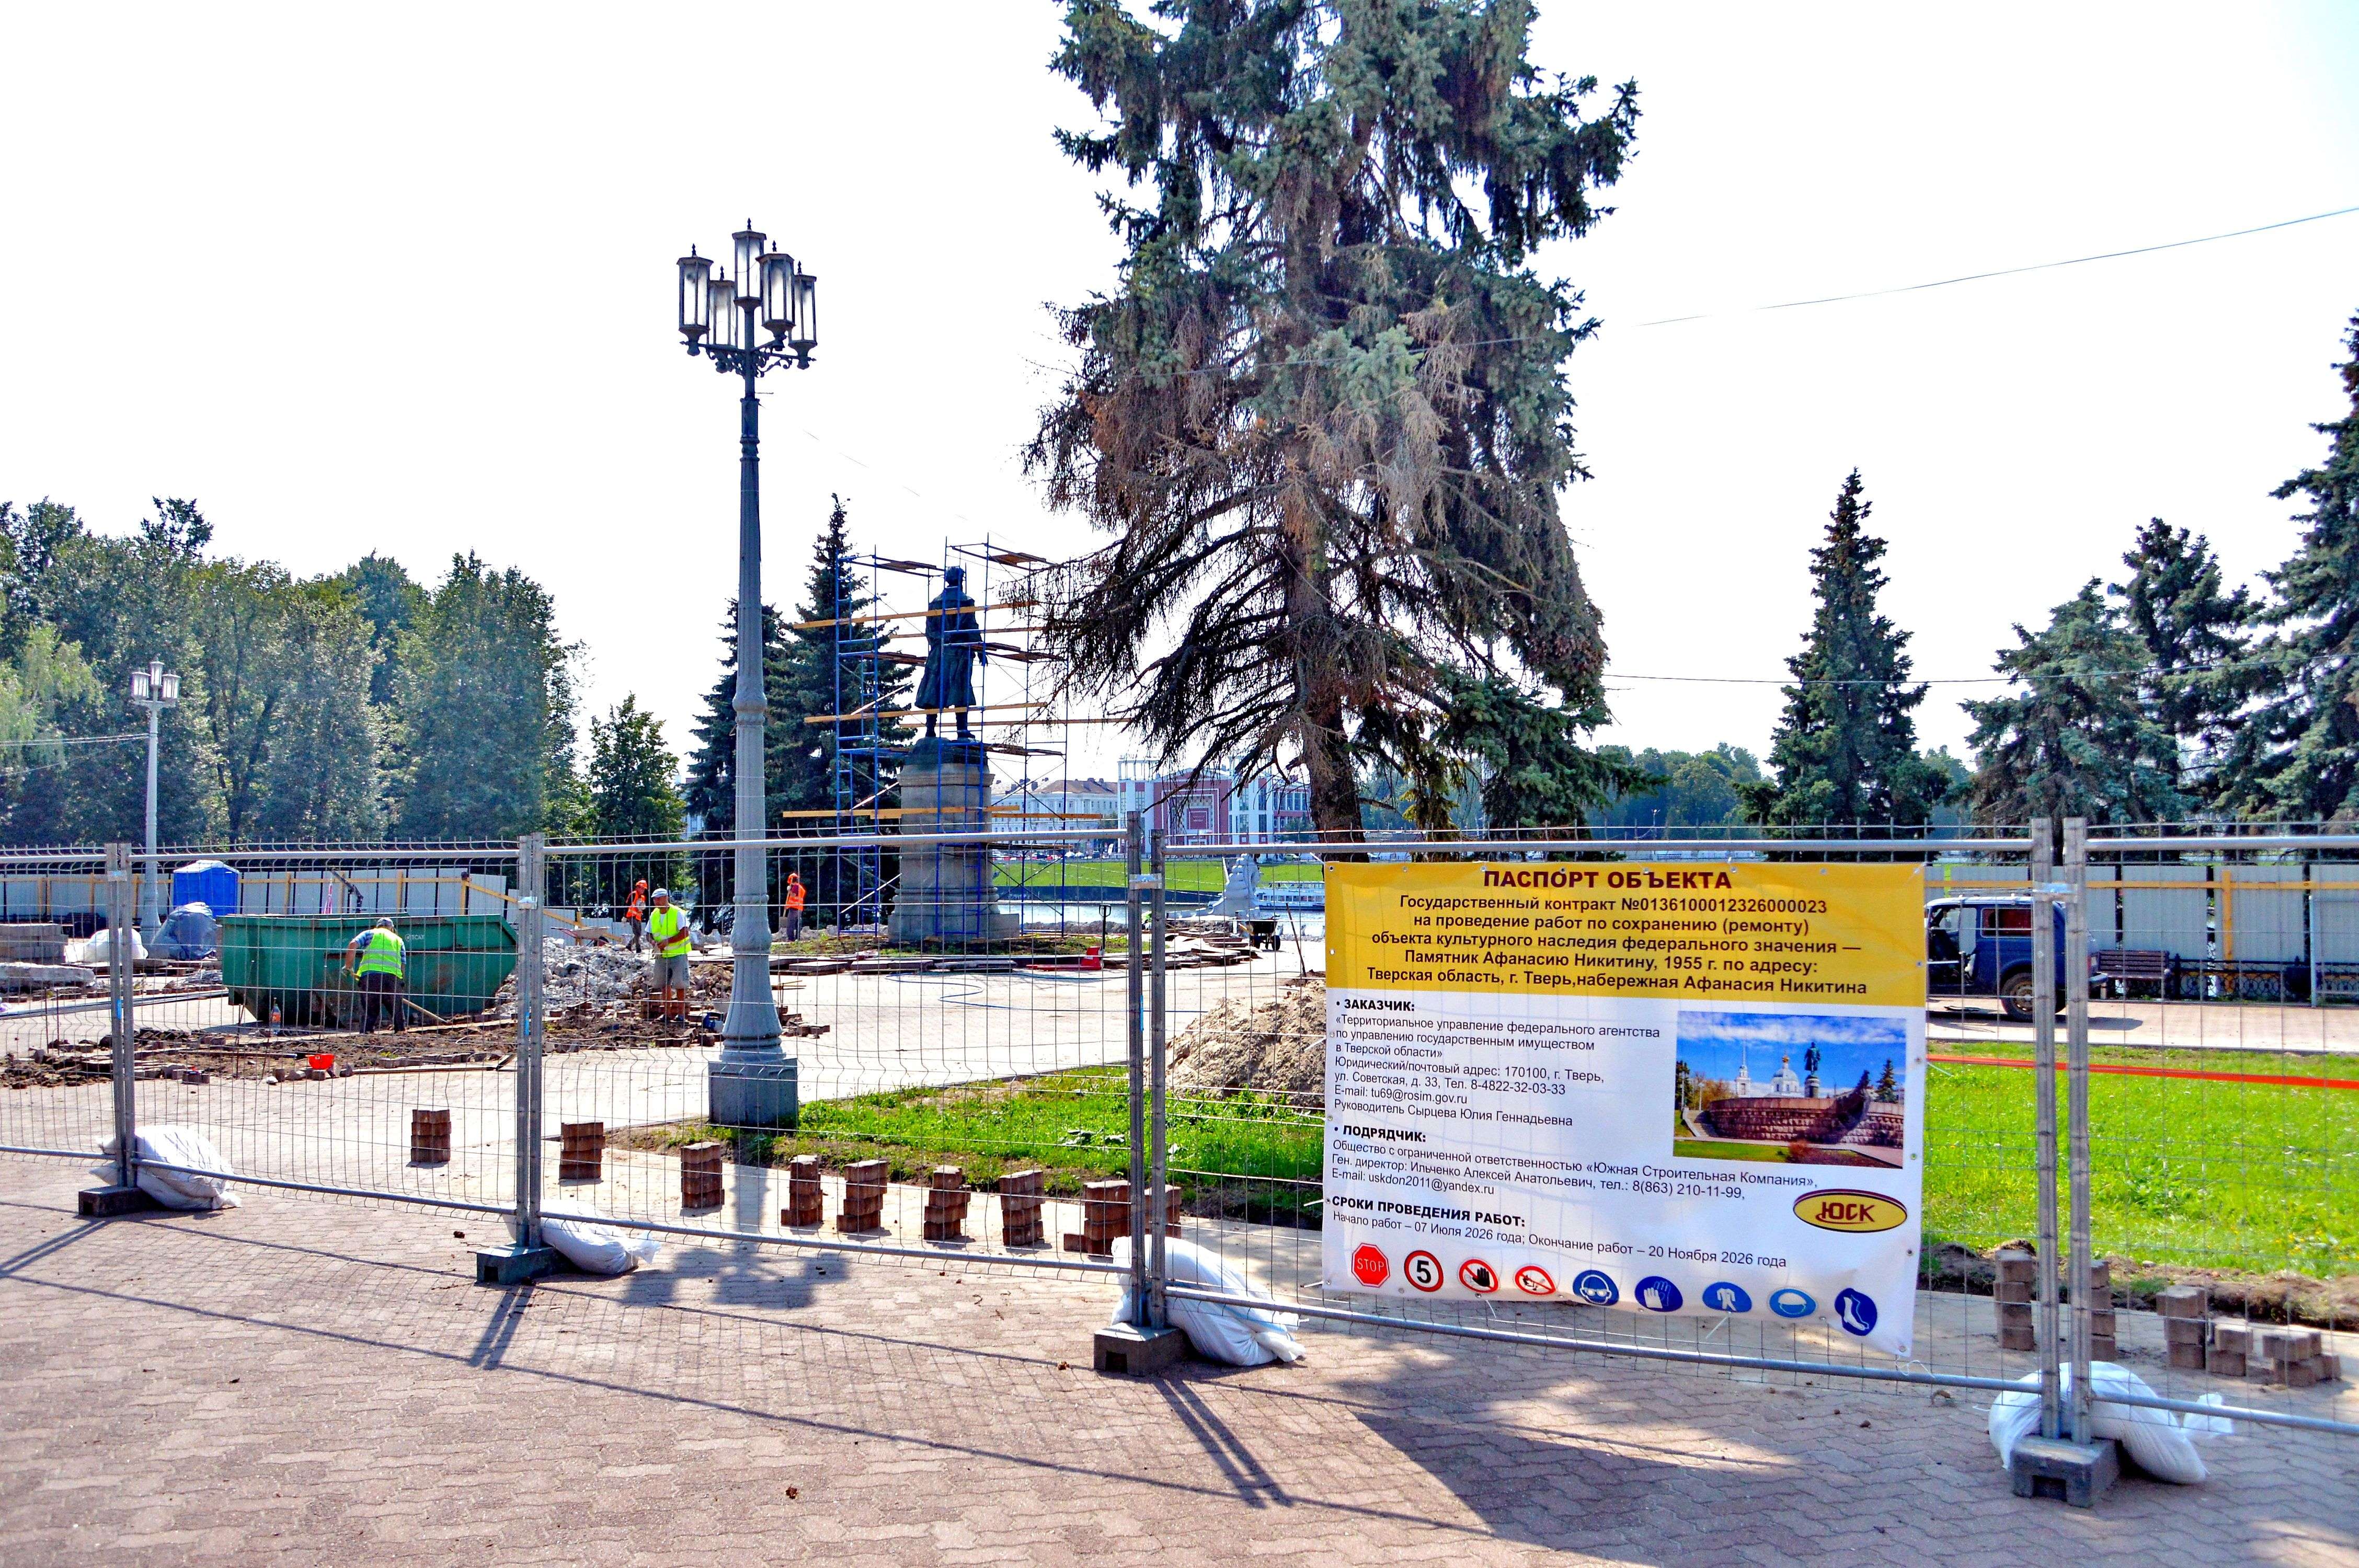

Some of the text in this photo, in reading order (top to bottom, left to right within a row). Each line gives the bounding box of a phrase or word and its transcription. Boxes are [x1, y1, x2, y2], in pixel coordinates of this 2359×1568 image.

[1484, 871, 1732, 889] ПАСПОРТ ОБЪЕКТА
[1400, 895, 1827, 913] Государственный контракт №0136100012326000023
[1414, 916, 1809, 936] на проведение работ по сохранению (ремонту)
[1372, 932, 1432, 944] объекта
[1437, 935, 1533, 948] культурного
[1538, 938, 1617, 949] наследия
[1622, 937, 1748, 952] федерального
[1754, 942, 1836, 953] значения
[1405, 950, 1817, 975] Памятник Афанасию Никитину, 1955 г. по адресу:
[1367, 967, 1866, 994] Тверская область, г. Тверь,набережная Афанасия Никитина
[1344, 999, 1414, 1011] ЗАКАЗЧИК:
[1336, 1014, 1660, 1037] «Территориальное управление федерального агентства
[1344, 1042, 1391, 1055] Тверской
[1394, 1046, 1442, 1058] области»
[1350, 1031, 1413, 1042] управлению
[1417, 1034, 1514, 1046] государственным
[1519, 1039, 1595, 1051] имуществом
[1335, 1056, 1459, 1074] Юридический/почтовый
[1463, 1067, 1501, 1077] адрес:
[1505, 1066, 1550, 1080] 170100,
[1565, 1069, 1604, 1083] Тверь,
[1334, 1071, 1565, 1095] ул. Советская, д. 33, Тел. 8-4822-32-03-33
[1335, 1085, 1467, 1104] E-mail: tu69@rosim.gov.ru
[1335, 1099, 1573, 1126] Руководитель Сырцева Юлия Геннадьевна
[1343, 1125, 1426, 1142] ПОДРЯДЧИК:
[1333, 1139, 1385, 1154] Общество
[1398, 1148, 1471, 1162] ограниченной
[1475, 1155, 1582, 1171] ответственностью
[1587, 1162, 1638, 1175] «Южная
[1642, 1166, 1735, 1182] Строительная
[1740, 1172, 1817, 1187] Компания»,
[1332, 1154, 1745, 1200] Ген. директор: Ильченко Алексей Анатольевич, тел.: 8(863) 210-11-99,
[1333, 1168, 1494, 1194] E-mail: uskdon2011@yandex.ru
[1332, 1196, 1525, 1227] СРОКИ ПРОВЕДЕНИЯ РАБОТ:
[1822, 1202, 1875, 1223] ЮСК
[1333, 1211, 1368, 1226] Начало
[1372, 1217, 1402, 1229] работ
[1415, 1221, 1427, 1232] 07
[1432, 1224, 1461, 1237] Июля
[1465, 1227, 1493, 1240] 2026
[1497, 1232, 1525, 1244] года;
[1529, 1234, 1594, 1251] Окончание
[1598, 1242, 1633, 1254] работ
[1648, 1246, 1664, 1257] 20
[1668, 1248, 1717, 1263] Ноября
[1721, 1251, 1753, 1265] 2026
[1757, 1256, 1787, 1269] года
[1357, 1258, 1384, 1272] STOP
[1416, 1260, 1432, 1283] 5
